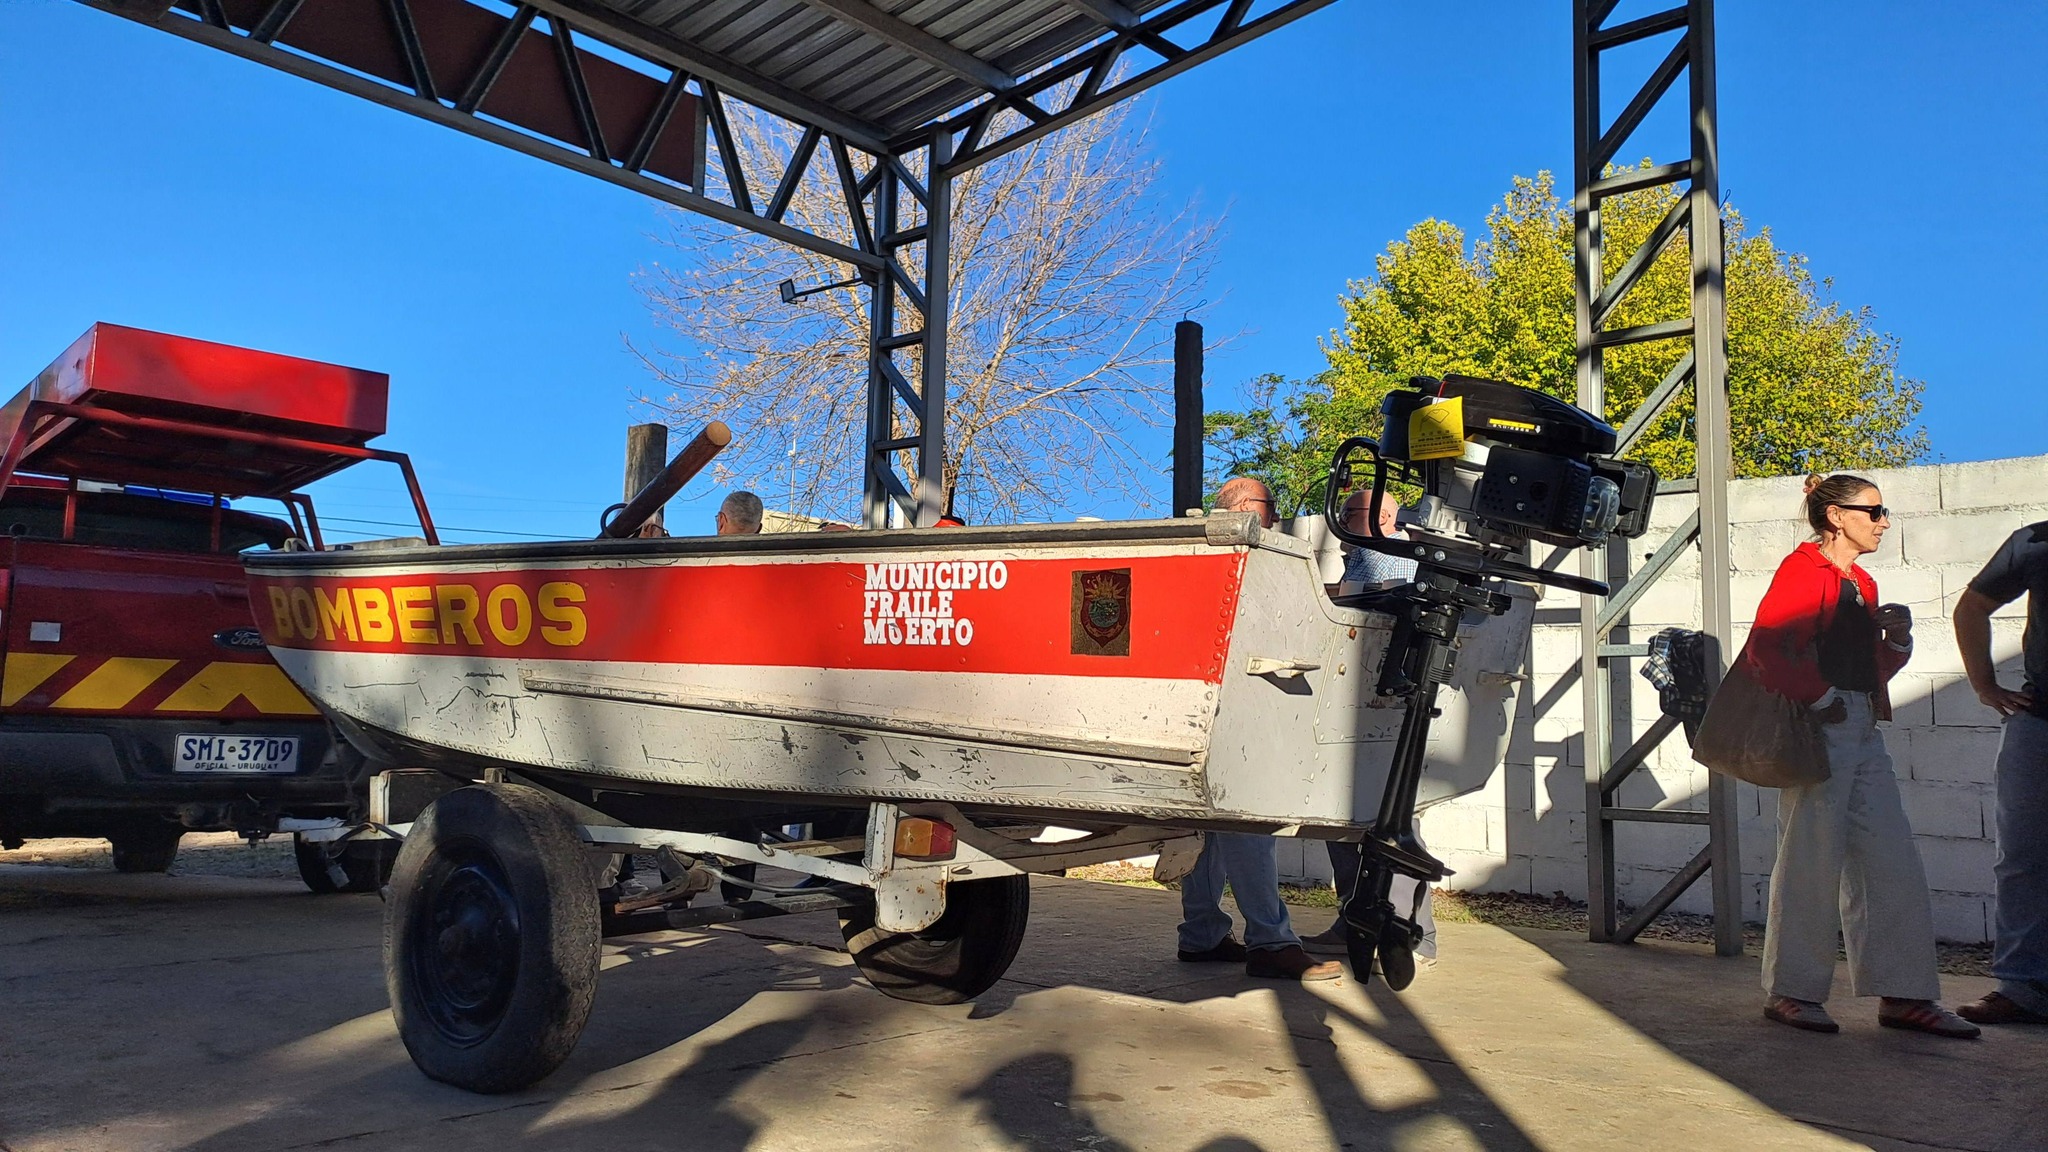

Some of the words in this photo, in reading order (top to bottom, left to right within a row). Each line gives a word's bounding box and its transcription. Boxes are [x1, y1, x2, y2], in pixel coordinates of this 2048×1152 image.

[865, 561, 1008, 590] MUNICIPIO
[268, 582, 587, 646] BOMBEROS
[864, 591, 953, 618] FRAILE
[864, 617, 974, 646] MUERTO
[194, 762, 229, 770] OFICIAL
[237, 762, 278, 770] URUGUAY
